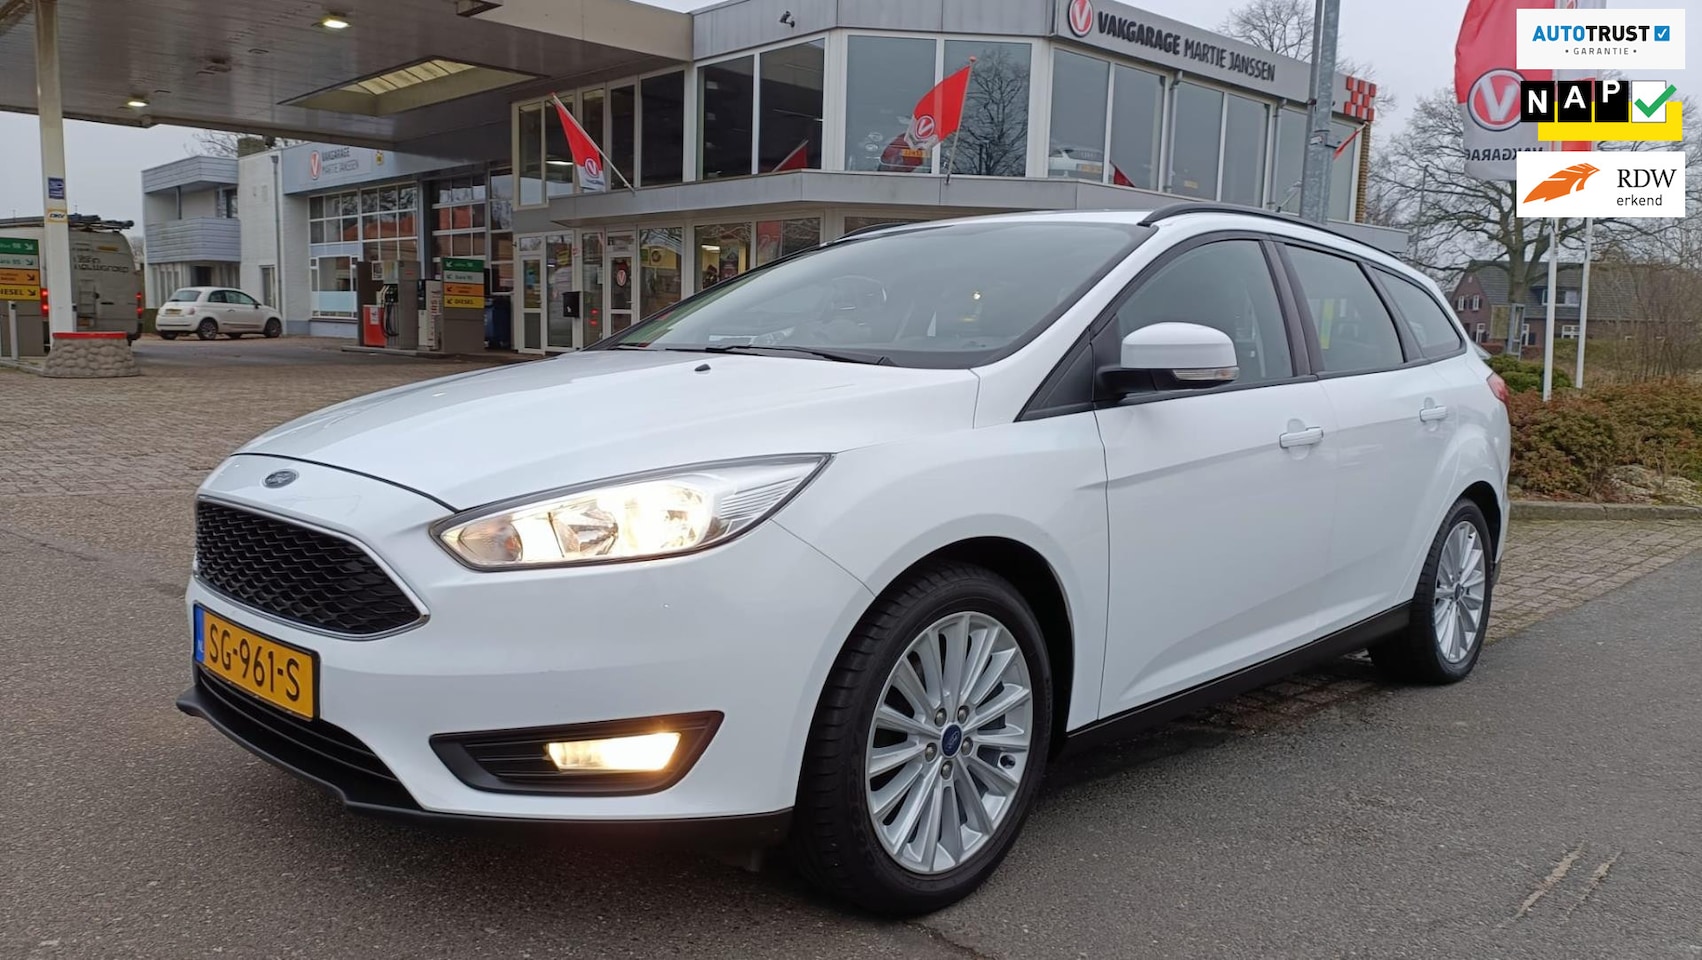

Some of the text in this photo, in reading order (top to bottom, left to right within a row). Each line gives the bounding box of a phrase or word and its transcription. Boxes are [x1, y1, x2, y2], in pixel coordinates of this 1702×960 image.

[1098, 11, 1276, 83] VAKGARAGE MARTIE JANSSEN
[0, 288, 25, 296] IESEL
[209, 623, 301, 702] SG-961-S
